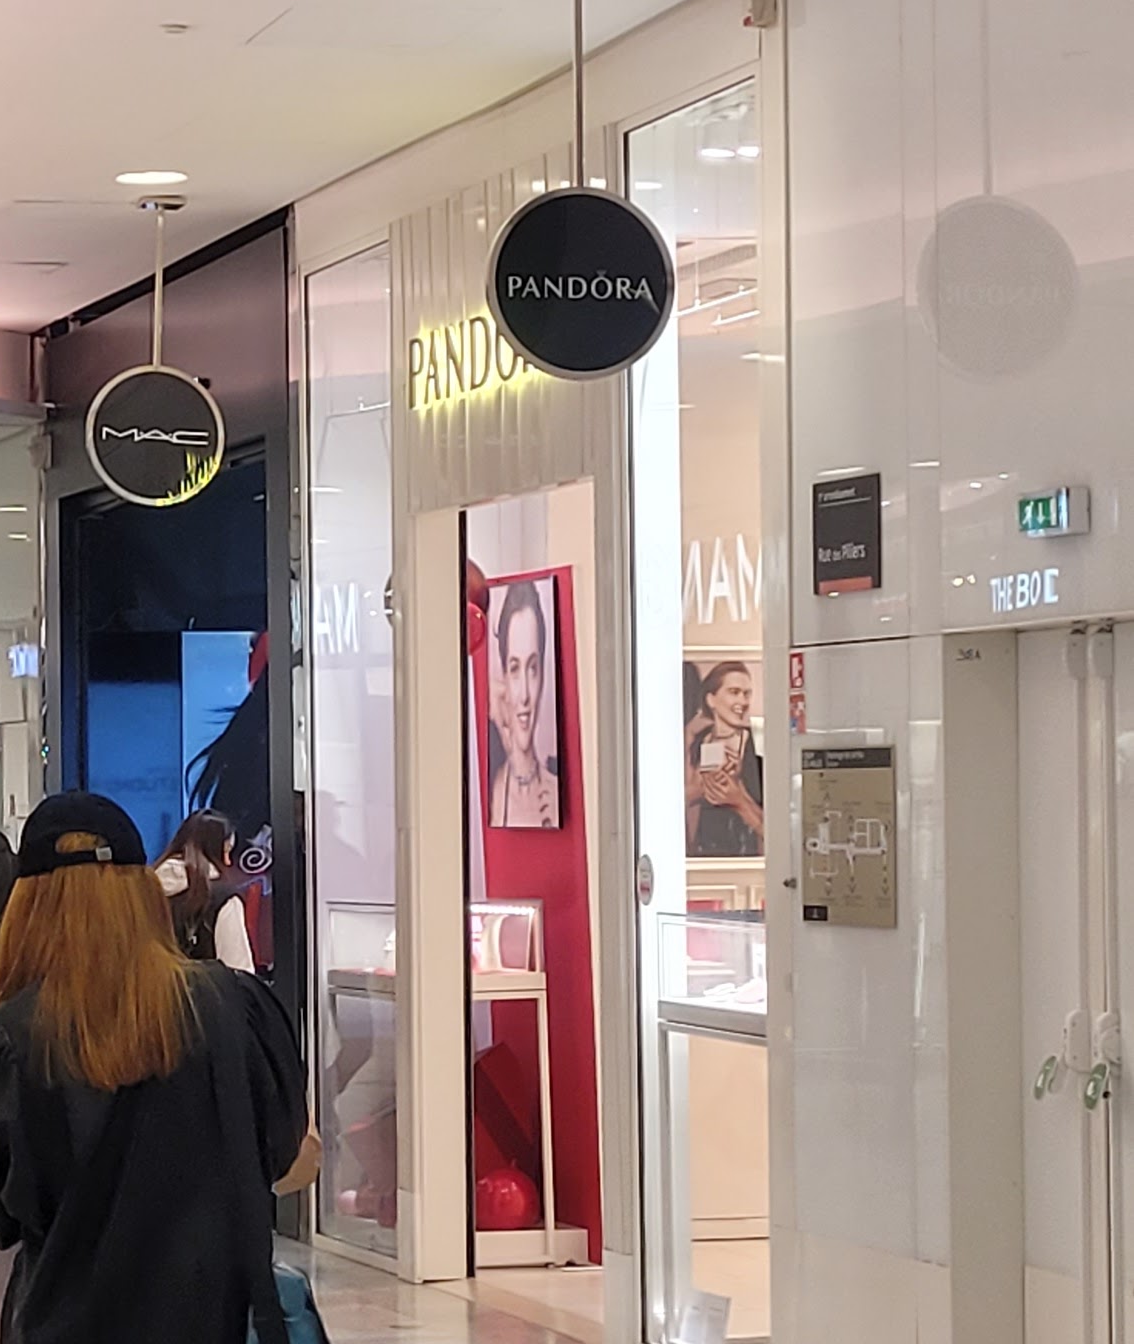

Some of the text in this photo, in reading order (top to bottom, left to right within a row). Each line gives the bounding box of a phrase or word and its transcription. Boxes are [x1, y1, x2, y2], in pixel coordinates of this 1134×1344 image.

[506, 270, 654, 300] PANDORA
[408, 316, 538, 410] PANDO
[989, 574, 1014, 613] THE
